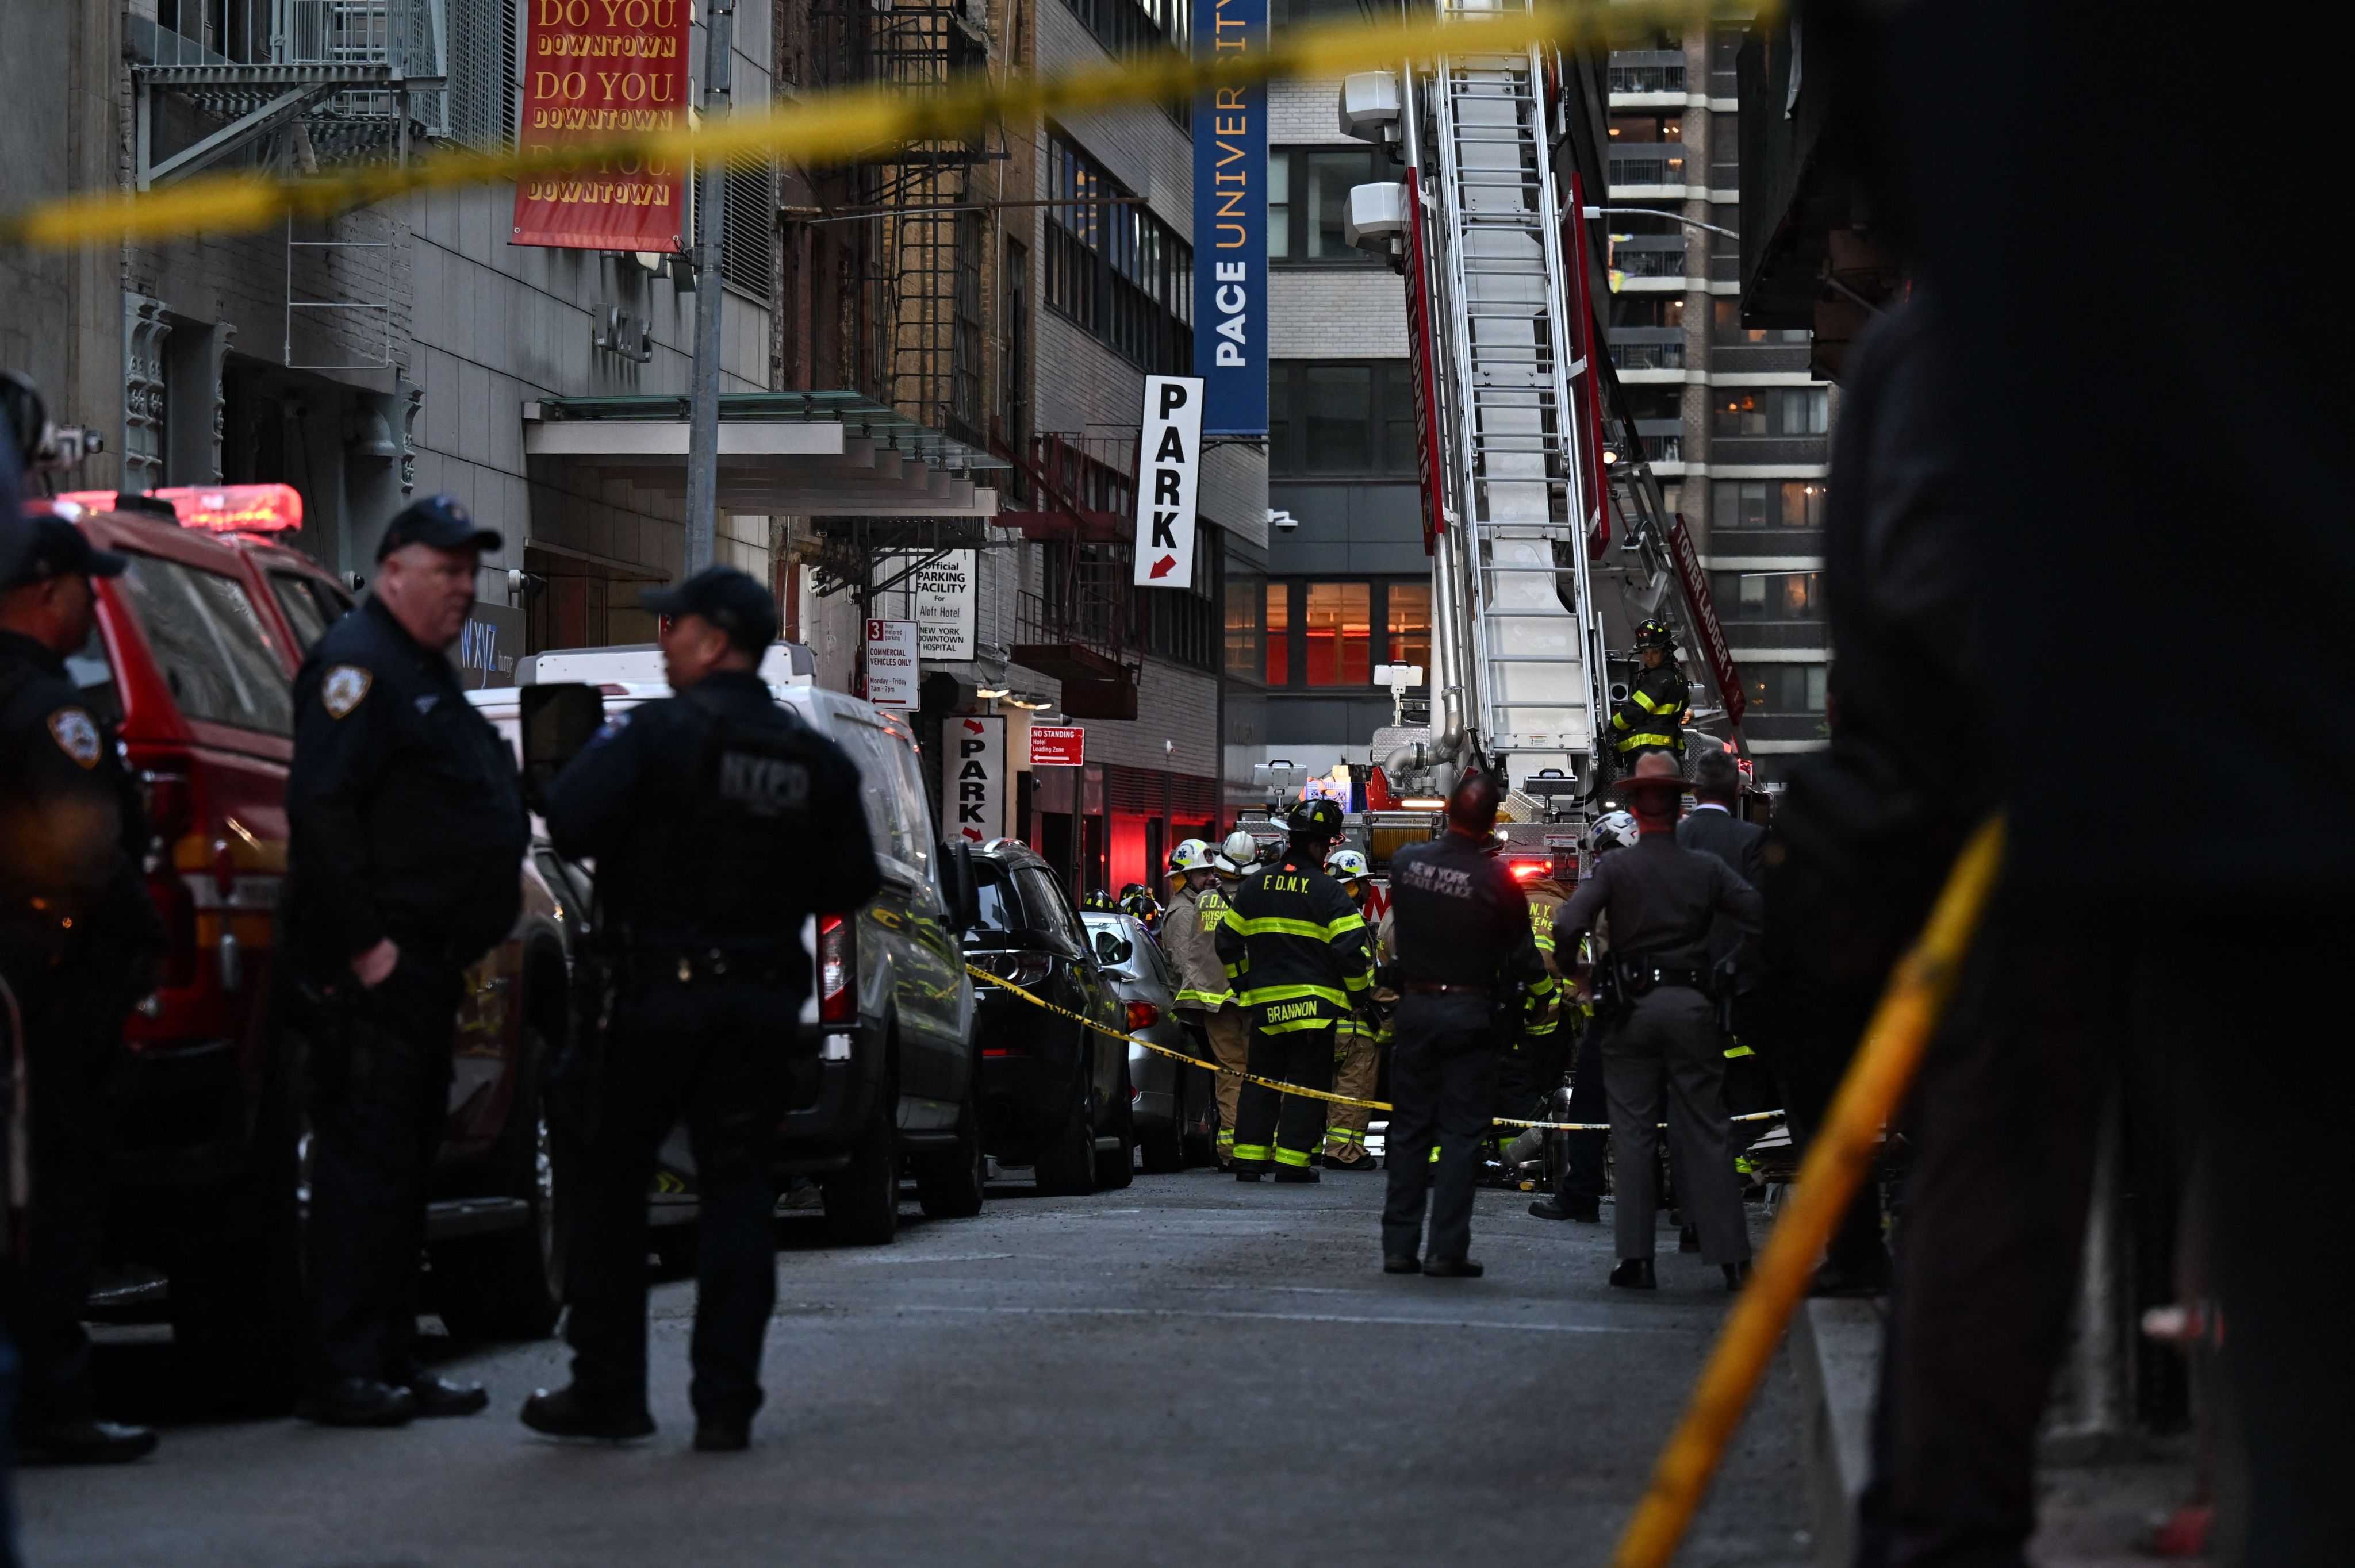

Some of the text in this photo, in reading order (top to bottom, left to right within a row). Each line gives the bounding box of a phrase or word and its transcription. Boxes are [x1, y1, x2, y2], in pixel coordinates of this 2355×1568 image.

[538, 0, 589, 26] DO
[537, 34, 676, 58] DOWNTOWN
[534, 72, 674, 102] DO YOU.
[532, 107, 673, 132] DOWNTOWN
[527, 180, 669, 206] DOWNTOWN
[1216, 262, 1246, 366] PACE
[1409, 305, 1426, 447] LADDER
[1419, 443, 1428, 485] 15
[1150, 384, 1187, 549] PARK
[918, 572, 965, 582] PARKING
[918, 583, 966, 593] FACILITY
[1677, 524, 1703, 598] TOWER
[1700, 591, 1728, 670] LADDER
[920, 606, 960, 618] Aloft Hotel
[872, 622, 880, 639] 3
[870, 648, 906, 656] COMMERCIAL
[870, 658, 896, 666] VEHICLES
[893, 678, 907, 686] Friday
[958, 740, 988, 823] PARK
[1438, 867, 1470, 886] YORK
[1534, 917, 1554, 931] EMS
[1267, 1001, 1317, 1023] BRANNON
